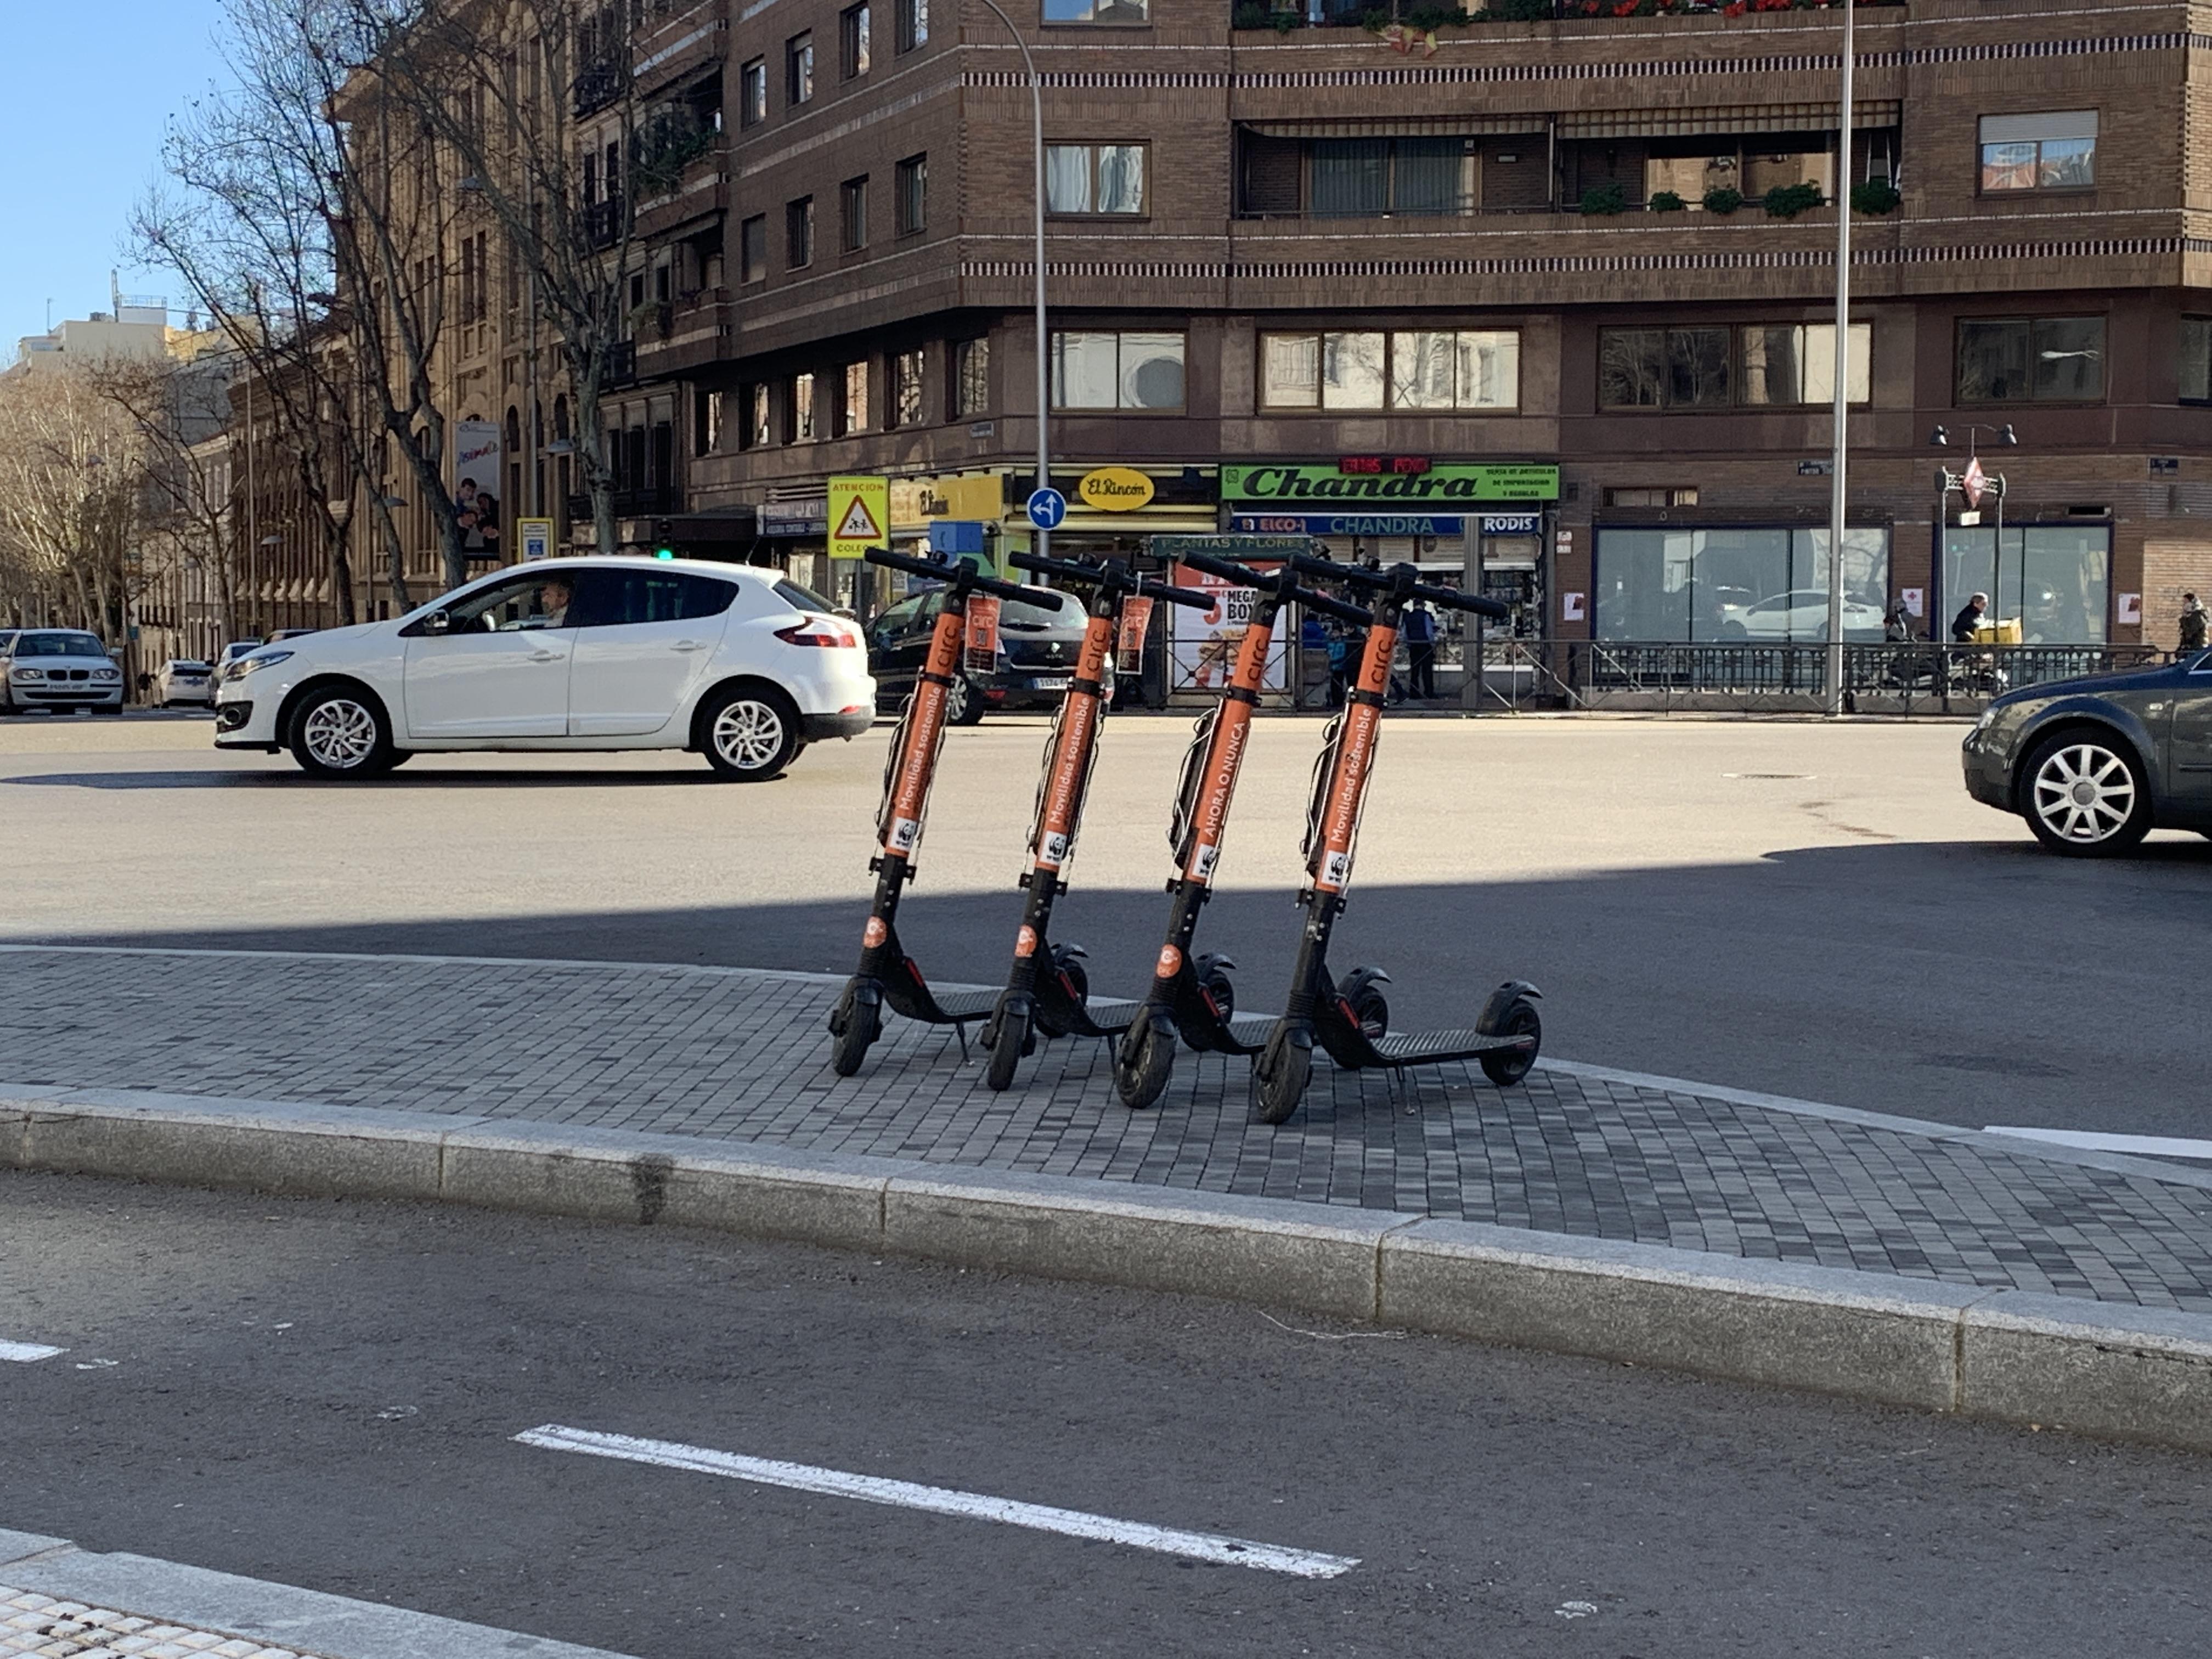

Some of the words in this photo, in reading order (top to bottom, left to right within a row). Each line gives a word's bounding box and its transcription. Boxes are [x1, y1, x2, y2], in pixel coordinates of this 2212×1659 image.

[1086, 478, 1099, 495] El
[1103, 478, 1146, 496] Rincón
[1243, 467, 1479, 497] Chandra
[1330, 517, 1435, 534] CHANDRA
[1484, 517, 1533, 532] RODIS
[1161, 538, 1231, 548] PLANTAS
[1234, 538, 1244, 548] Y
[1246, 538, 1305, 548] FLORES
[900, 749, 924, 810] Movilidad
[916, 686, 941, 749] sostenible
[1049, 761, 1075, 824] Movilidad
[1068, 697, 1091, 761] sostenible
[1222, 721, 1245, 770] NUNCA
[1219, 772, 1230, 786] O
[1330, 775, 1357, 843] Movilidad
[1348, 707, 1372, 774] sostenible
[1204, 788, 1228, 838] AHORA
